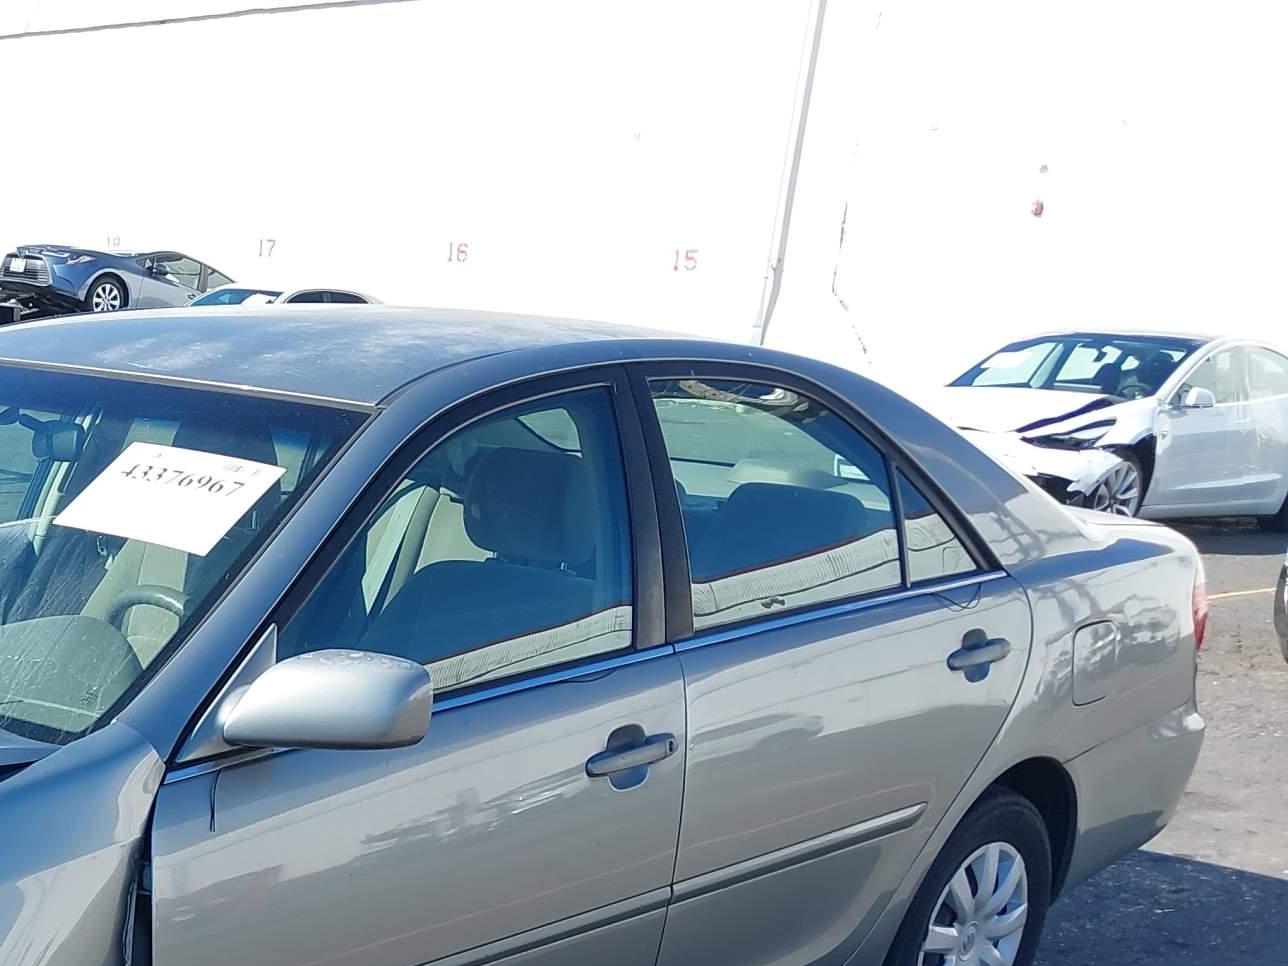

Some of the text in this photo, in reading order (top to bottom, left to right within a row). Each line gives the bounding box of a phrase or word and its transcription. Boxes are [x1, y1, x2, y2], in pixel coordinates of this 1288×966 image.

[259, 239, 276, 256] 17
[448, 242, 468, 262] 16
[674, 250, 698, 271] 15
[120, 463, 245, 497] 43376967
